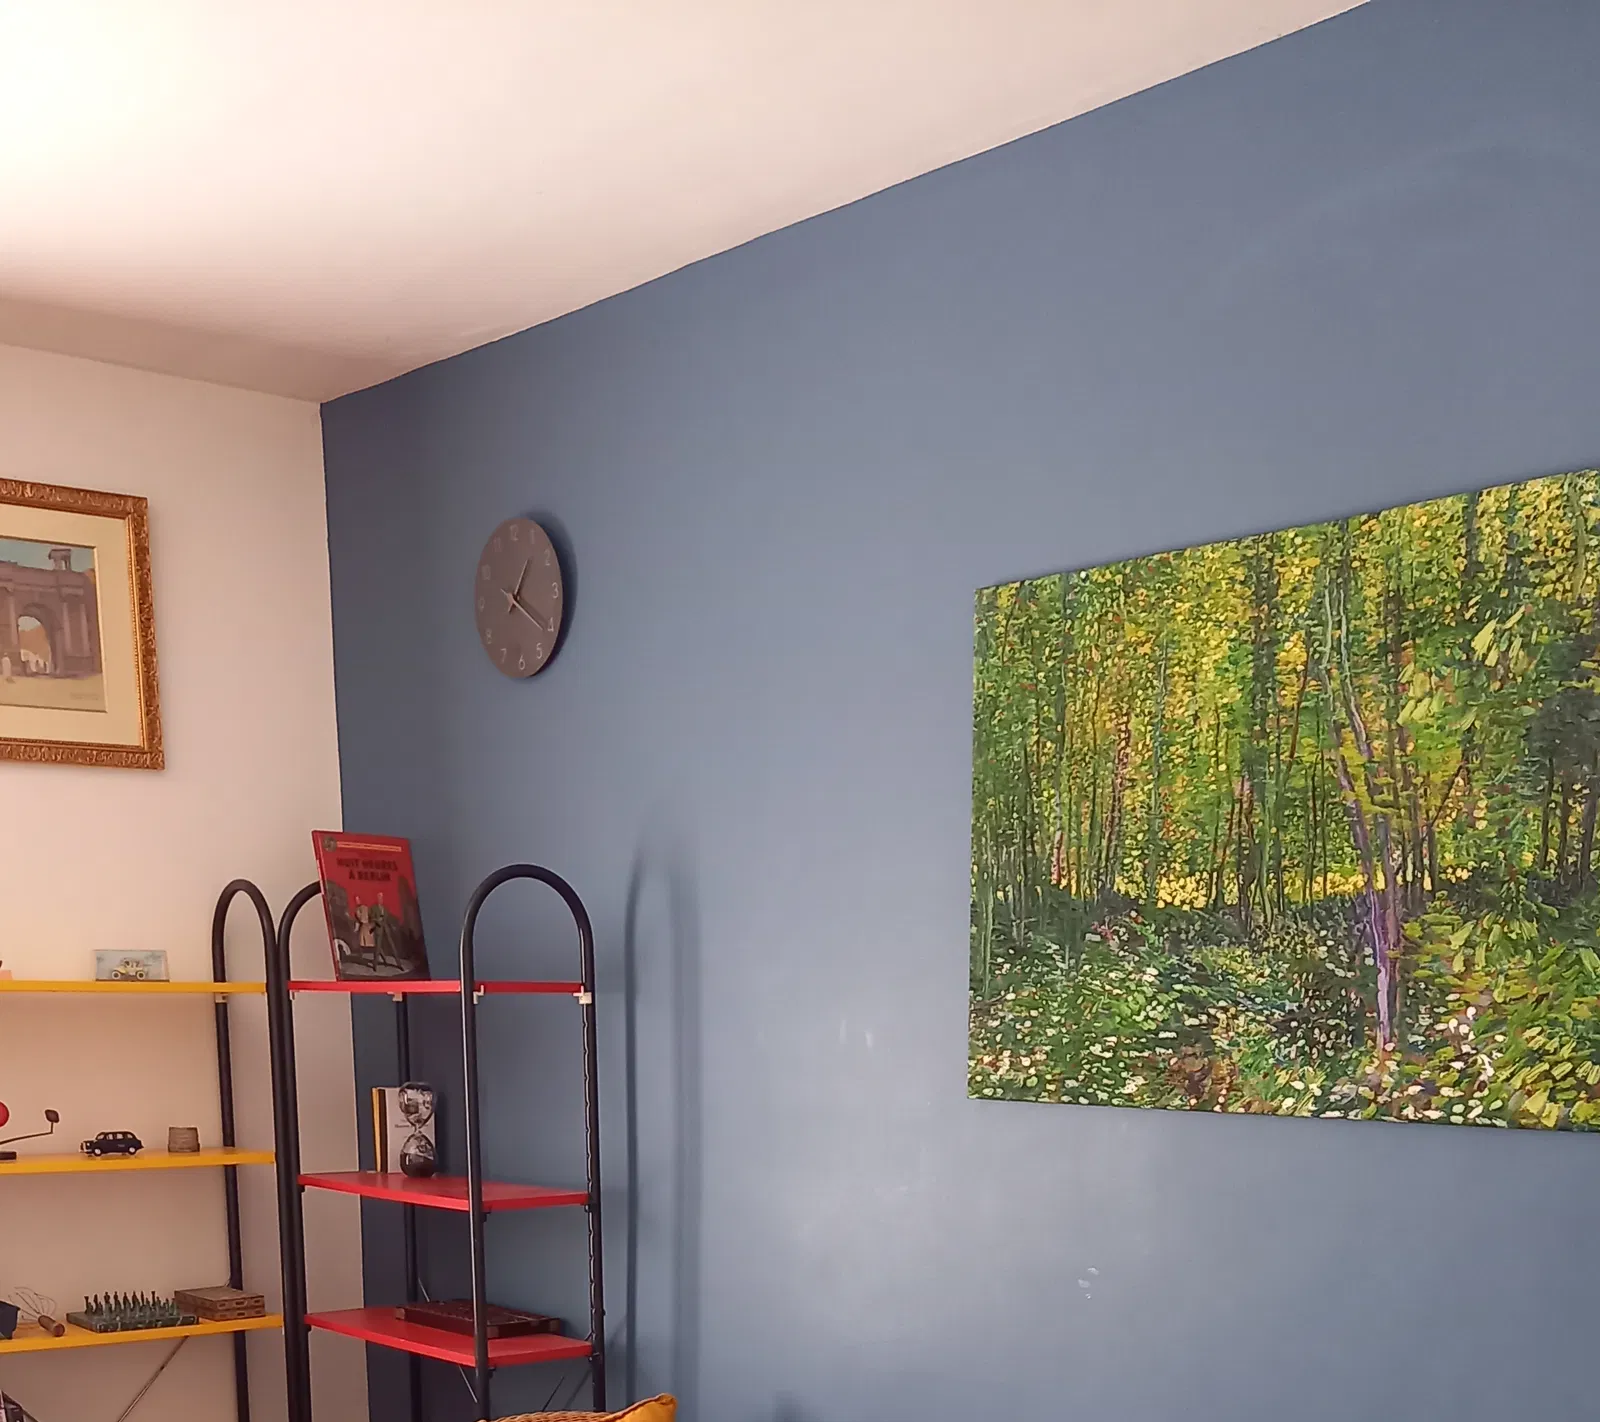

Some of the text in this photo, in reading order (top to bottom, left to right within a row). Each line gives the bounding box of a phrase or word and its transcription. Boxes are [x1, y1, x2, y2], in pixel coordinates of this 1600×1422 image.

[544, 550, 551, 566] 2
[551, 582, 559, 598] 3
[547, 617, 554, 632] 4
[500, 648, 508, 664] 7
[535, 642, 543, 659] 5
[518, 655, 526, 671] 6
